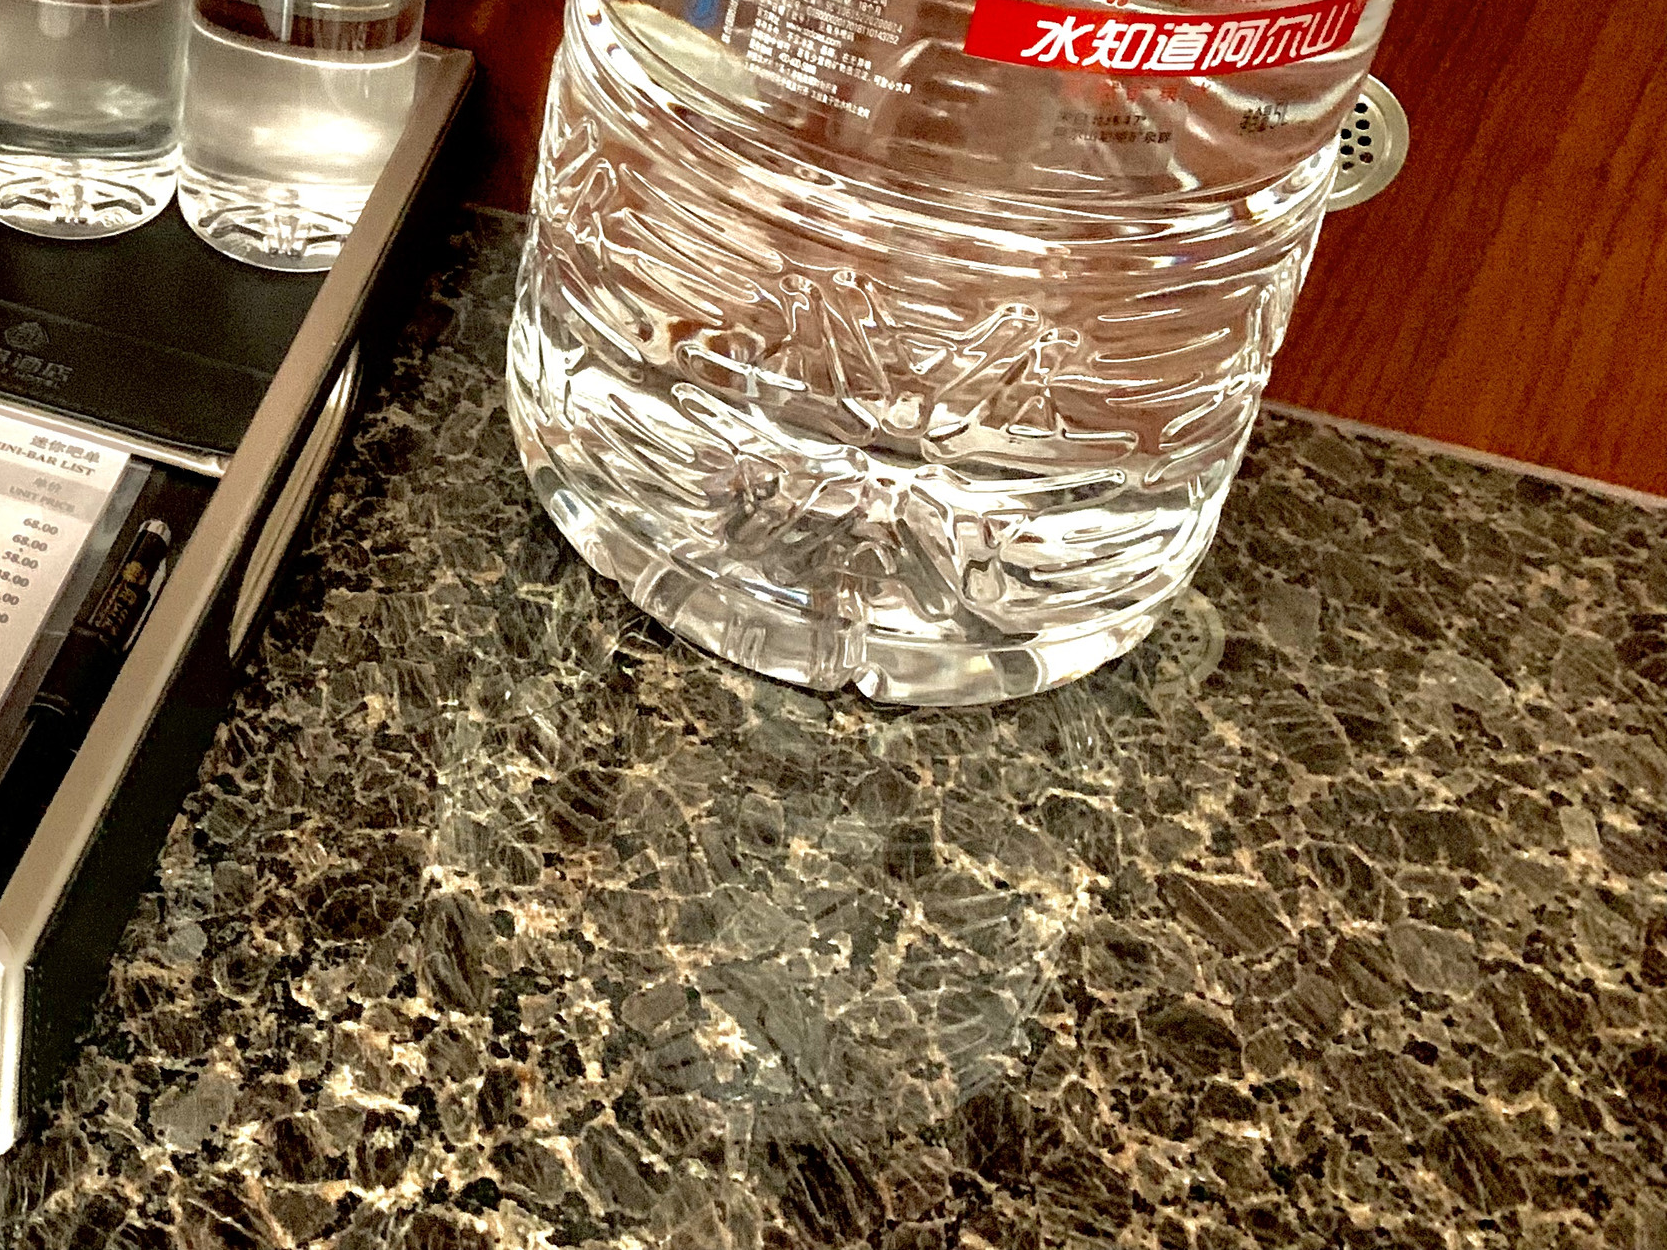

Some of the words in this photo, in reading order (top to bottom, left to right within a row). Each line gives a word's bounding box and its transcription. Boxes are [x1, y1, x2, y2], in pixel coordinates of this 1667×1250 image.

[1018, 0, 1352, 72] 水知道阿尔山
[29, 435, 101, 464] 迷你吧单
[59, 456, 96, 477] LIST
[8, 485, 40, 501] UNIT
[39, 495, 76, 512] PRICE
[21, 517, 60, 535] 68.00
[10, 533, 49, 552] 68.00
[0, 550, 40, 570] 58.00
